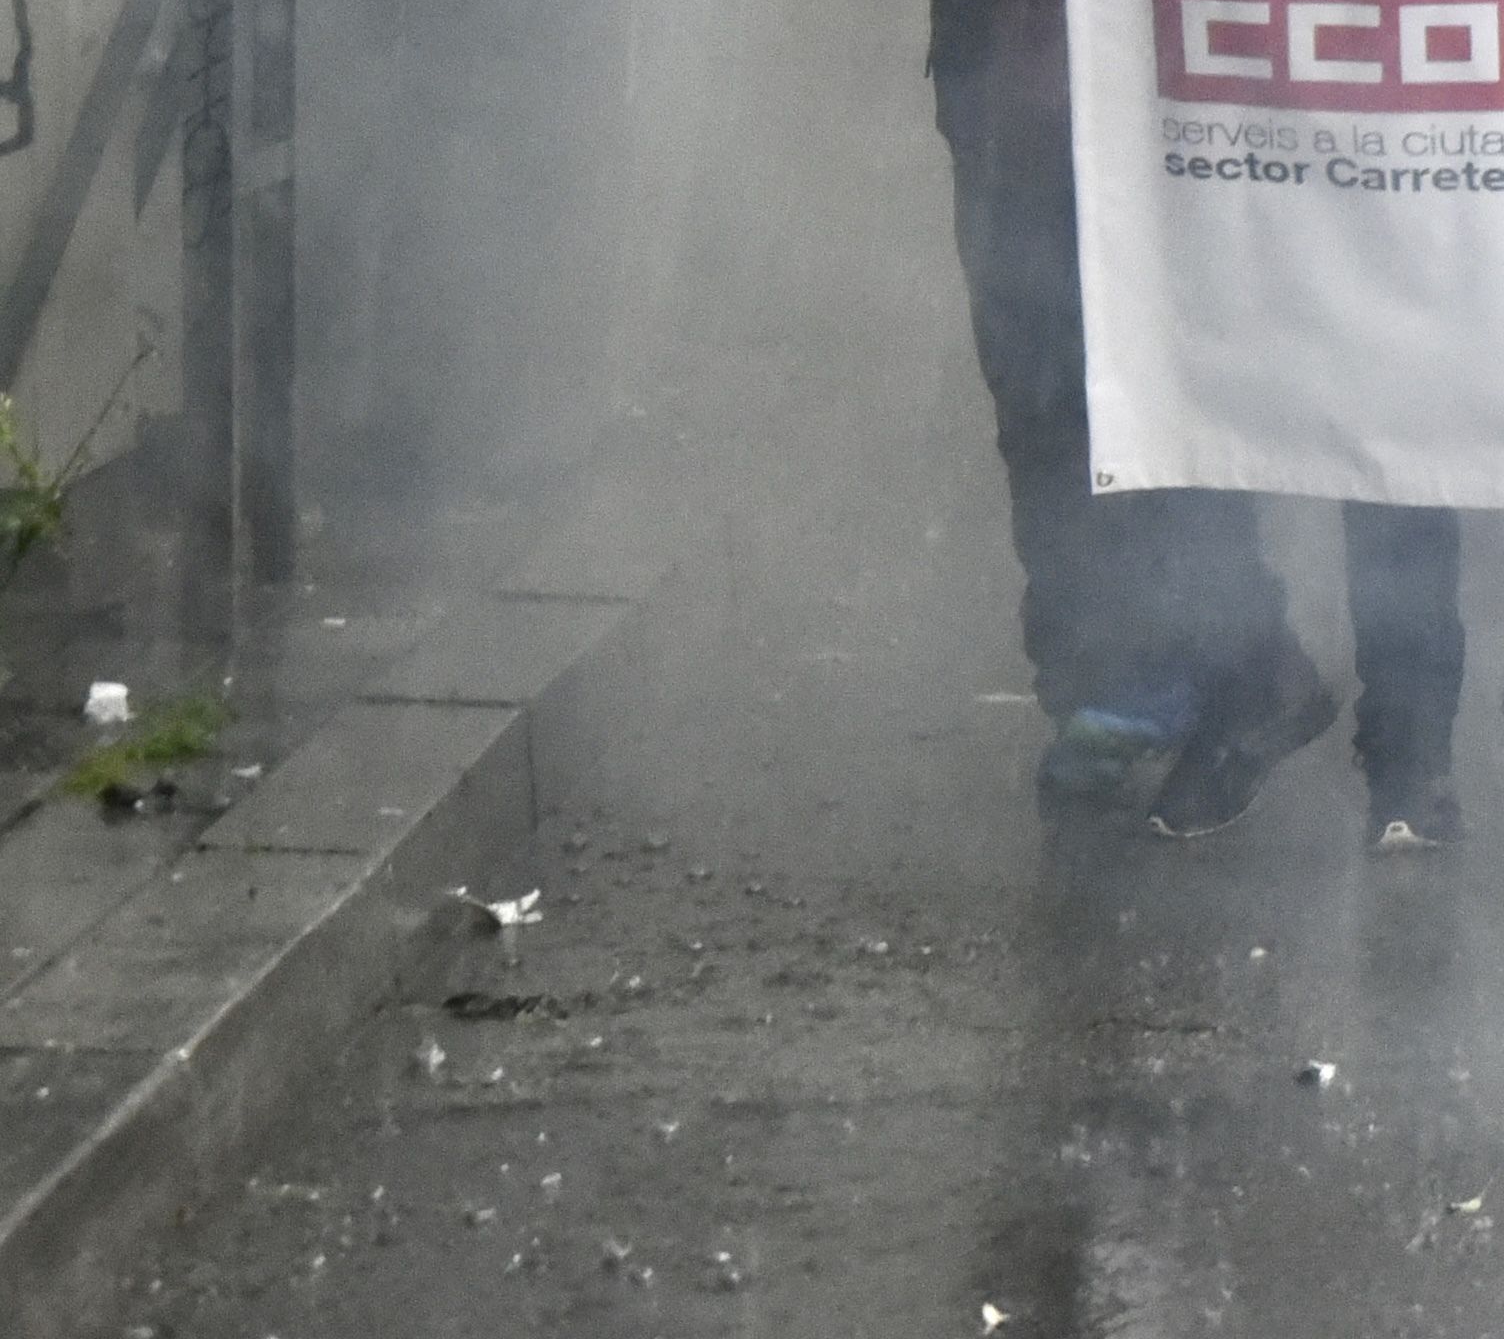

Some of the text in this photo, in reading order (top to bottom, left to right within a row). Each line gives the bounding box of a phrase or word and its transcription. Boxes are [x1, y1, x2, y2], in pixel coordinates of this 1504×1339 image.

[1160, 116, 1299, 151] serveis
[1313, 129, 1337, 156] a
[1353, 124, 1386, 156] la
[1164, 151, 1310, 184] sector
